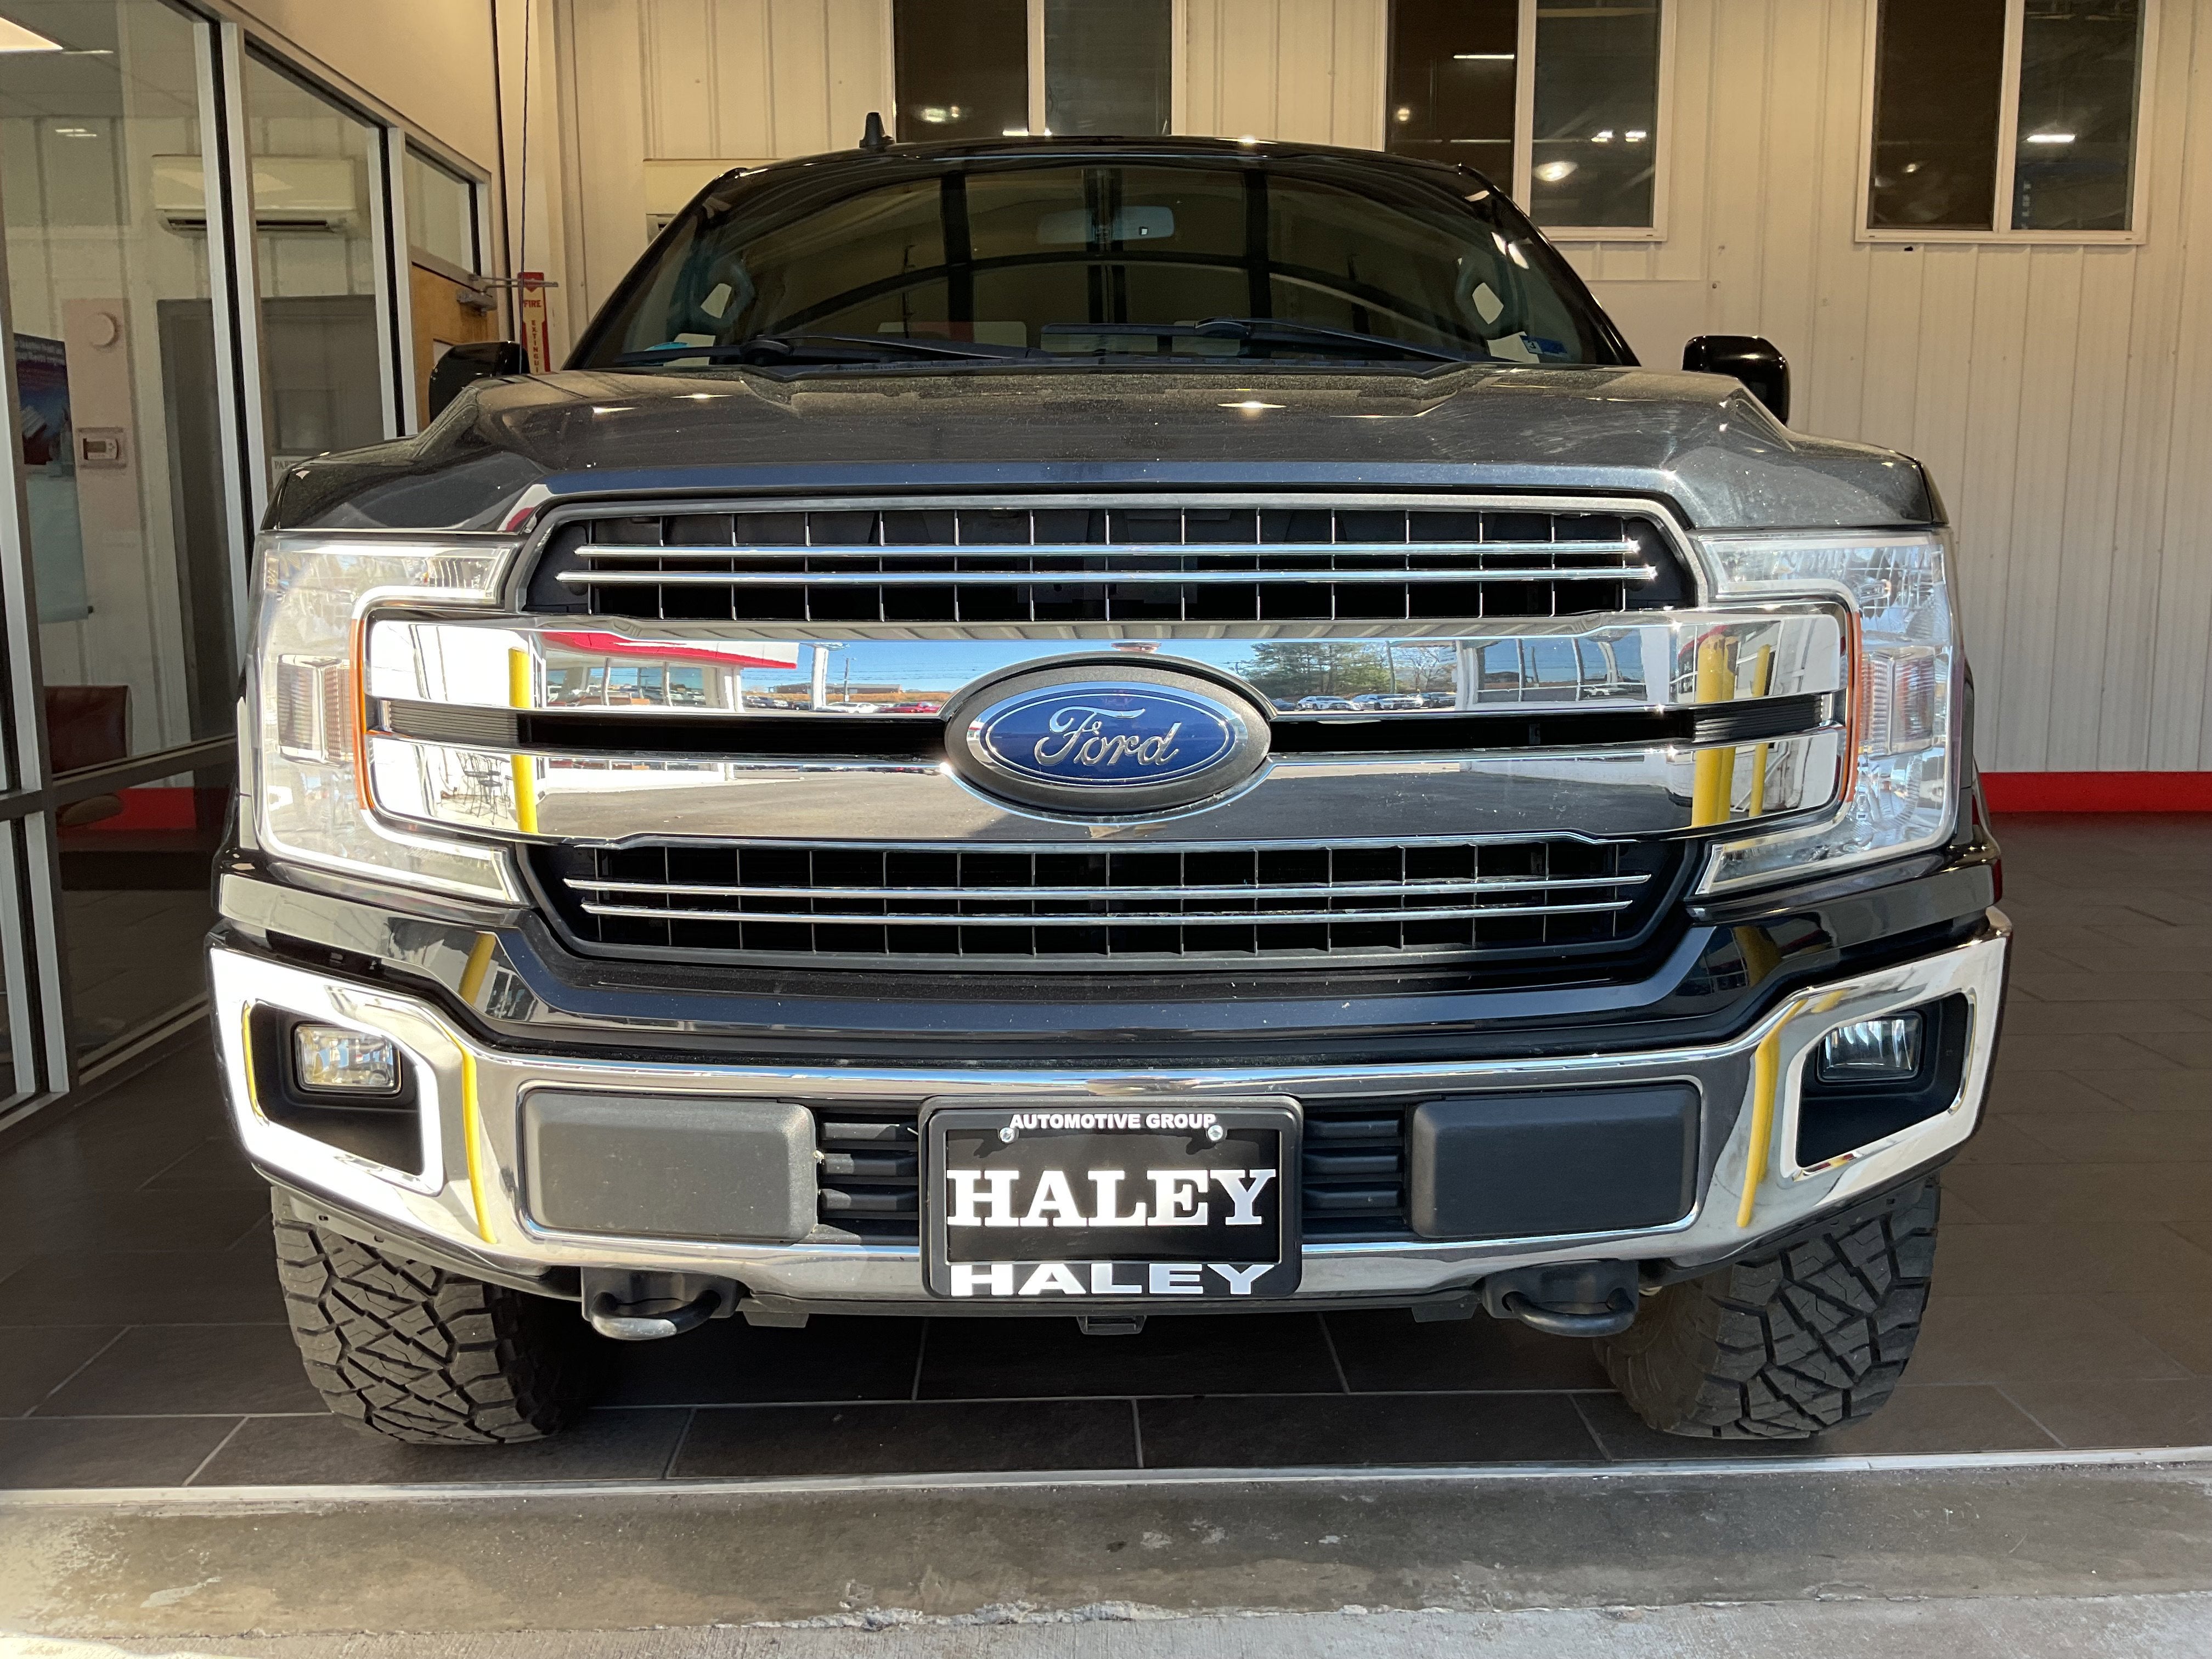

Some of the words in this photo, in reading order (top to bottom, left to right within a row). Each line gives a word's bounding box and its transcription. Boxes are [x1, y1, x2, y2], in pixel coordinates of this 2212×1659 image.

[523, 300, 541, 308] FIRE
[531, 320, 539, 373] EXTINGUI
[1034, 706, 1181, 766] Ford
[1010, 1114, 1141, 1129] AUTOMOTIVE
[1146, 1114, 1216, 1128] GROUP
[947, 1169, 1276, 1226] HALEY
[950, 1263, 1274, 1296] HALEY
